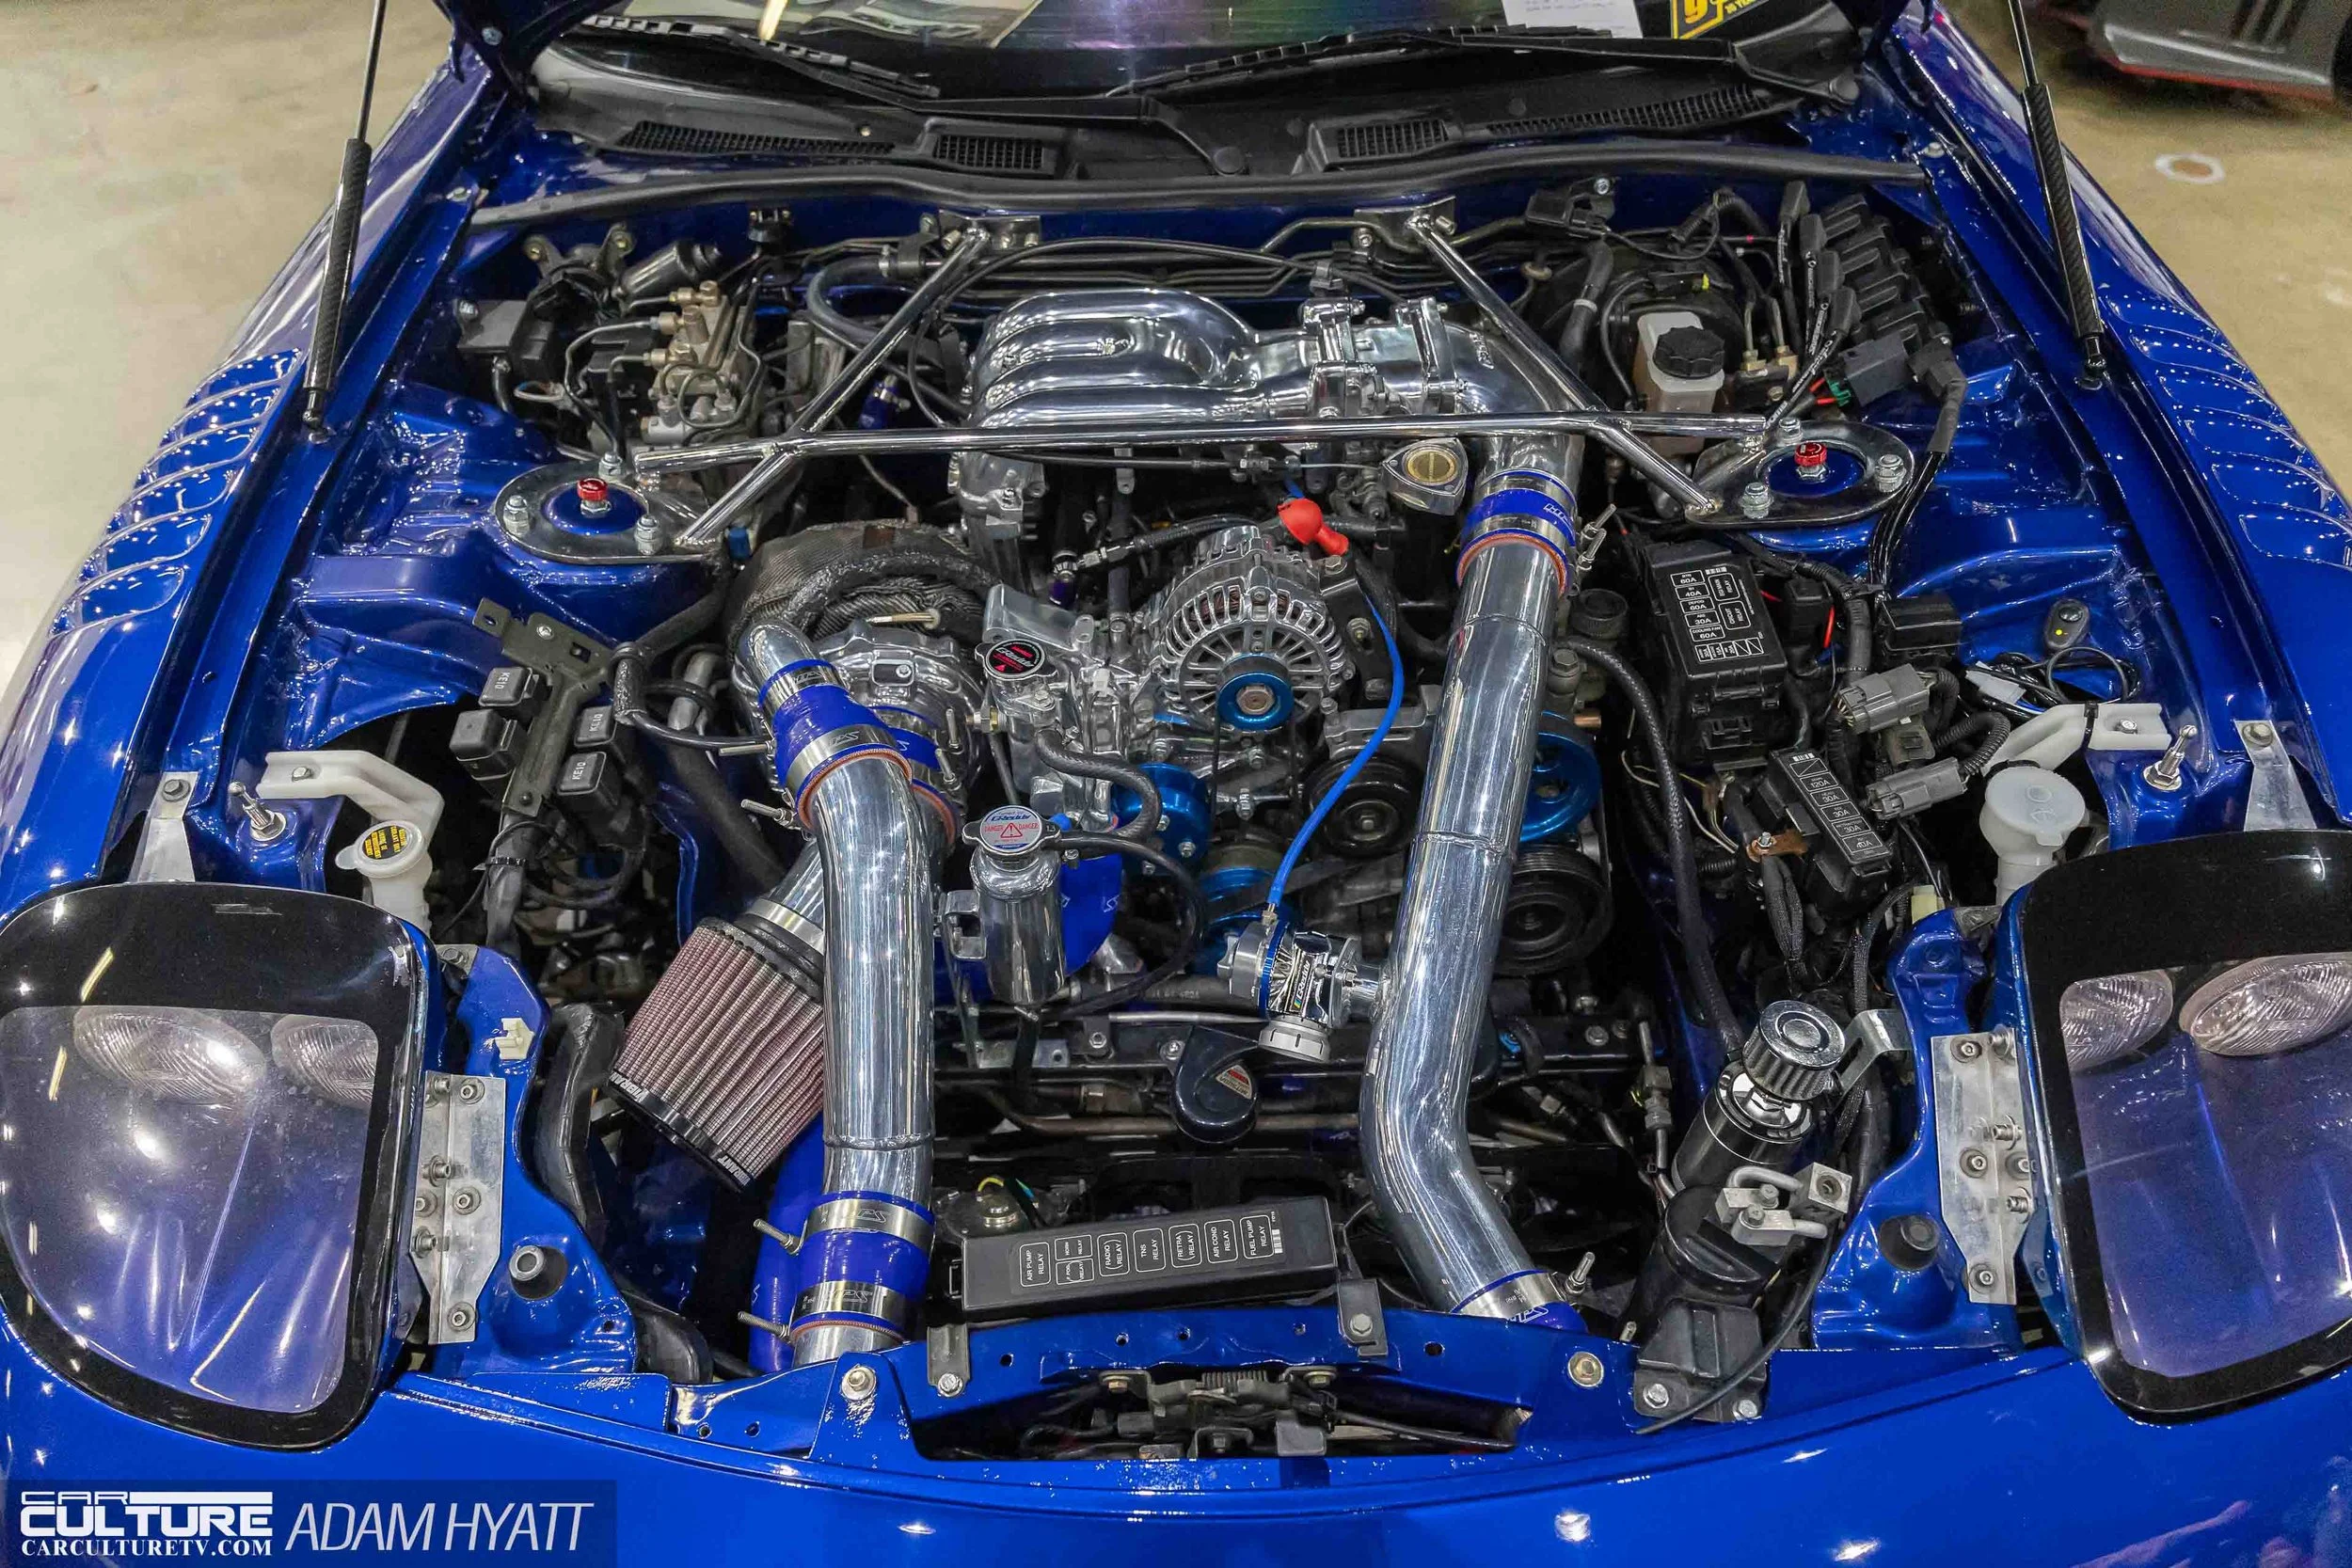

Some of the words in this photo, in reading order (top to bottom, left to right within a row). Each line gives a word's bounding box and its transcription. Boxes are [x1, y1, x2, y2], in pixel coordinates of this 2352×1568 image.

[1810, 780, 1831, 788] 120A
[1822, 794, 1840, 802] 30A
[1833, 809, 1850, 817] 30A
[1018, 822, 1040, 831] DANGER
[1296, 959, 1311, 999] GReddy
[609, 1071, 650, 1102] VIBRAN
[1247, 1219, 1255, 1239] PUMP
[1259, 1226, 1267, 1247] RELAY
[1222, 1229, 1231, 1251] RELAY
[1115, 1243, 1123, 1265] RELAY
[1212, 1245, 1220, 1258] AIR
